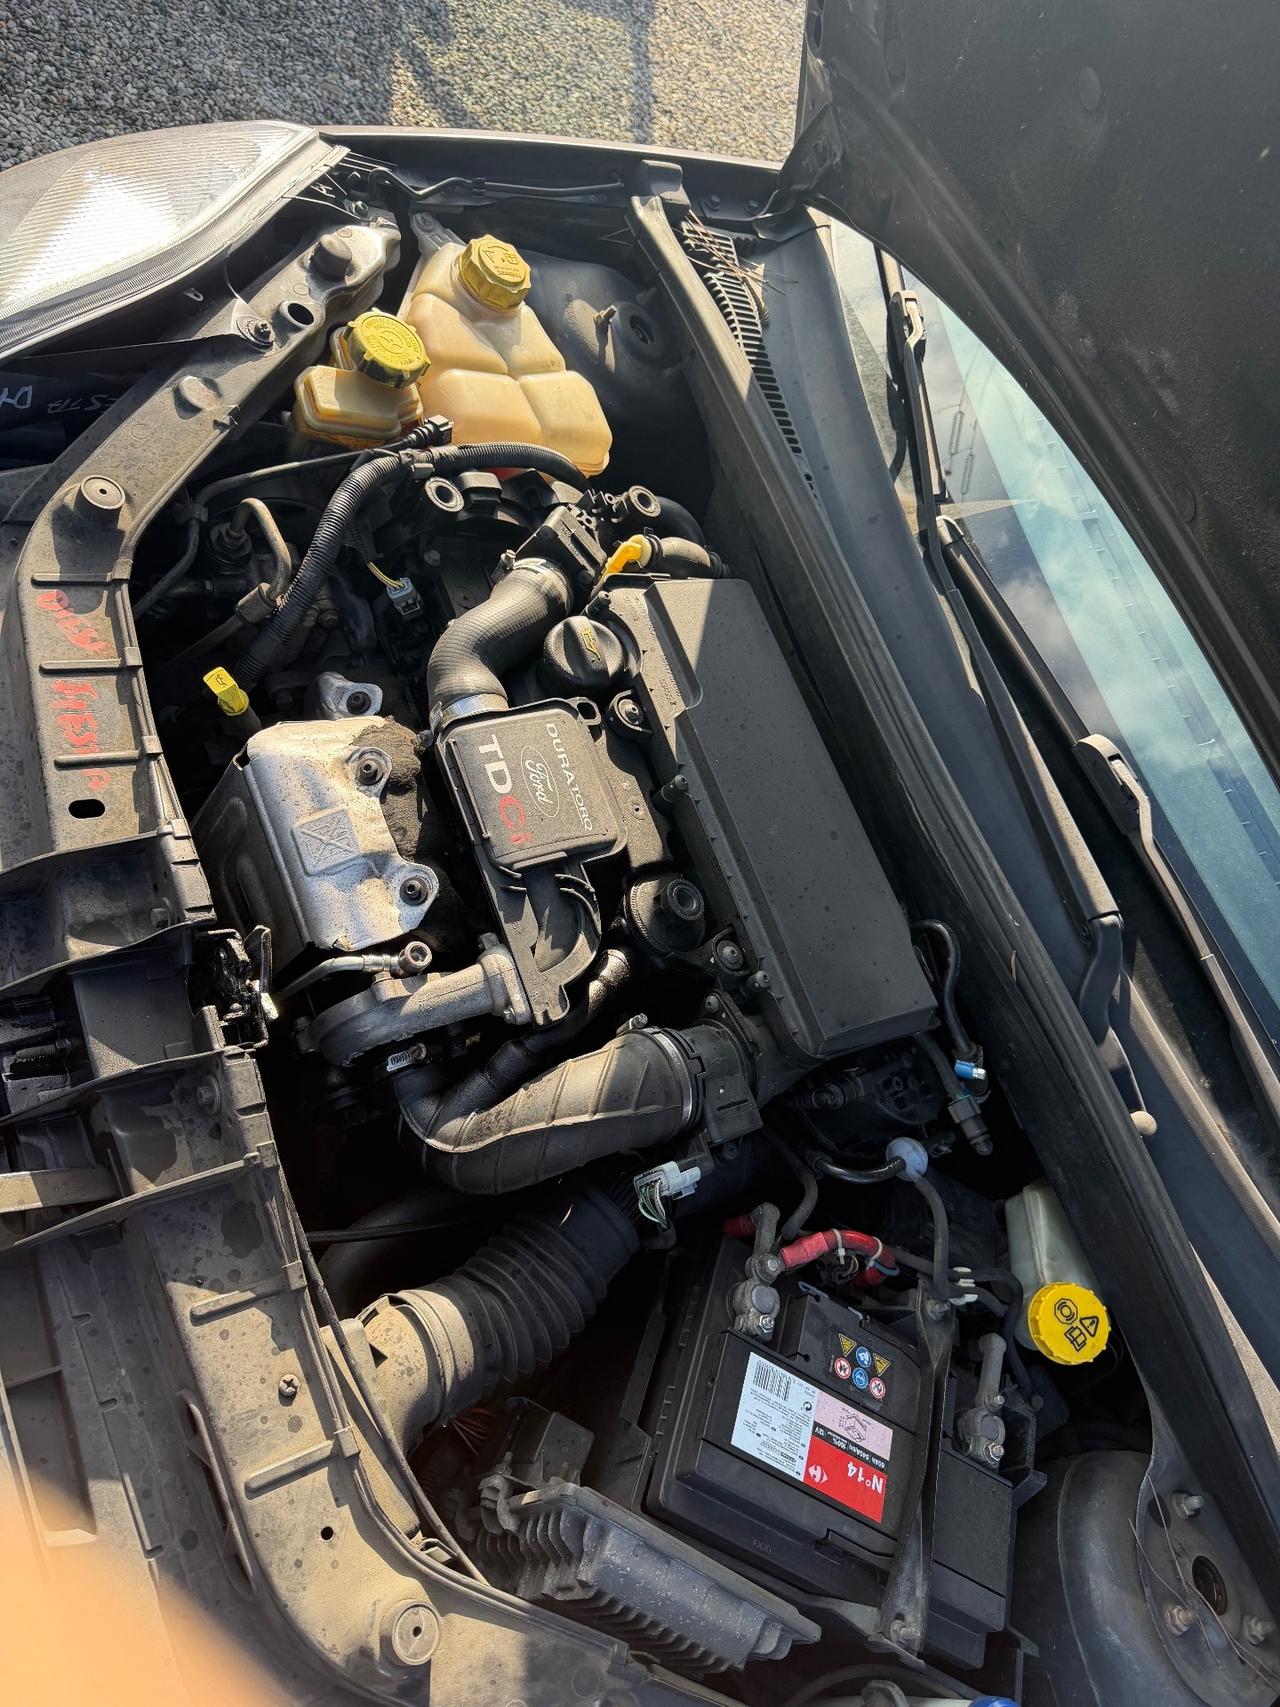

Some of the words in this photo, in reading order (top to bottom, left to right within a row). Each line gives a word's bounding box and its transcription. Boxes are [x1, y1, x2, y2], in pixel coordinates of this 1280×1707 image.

[478, 733, 534, 844] TDCi
[525, 759, 554, 806] Ford
[545, 722, 593, 831] DURATORQ
